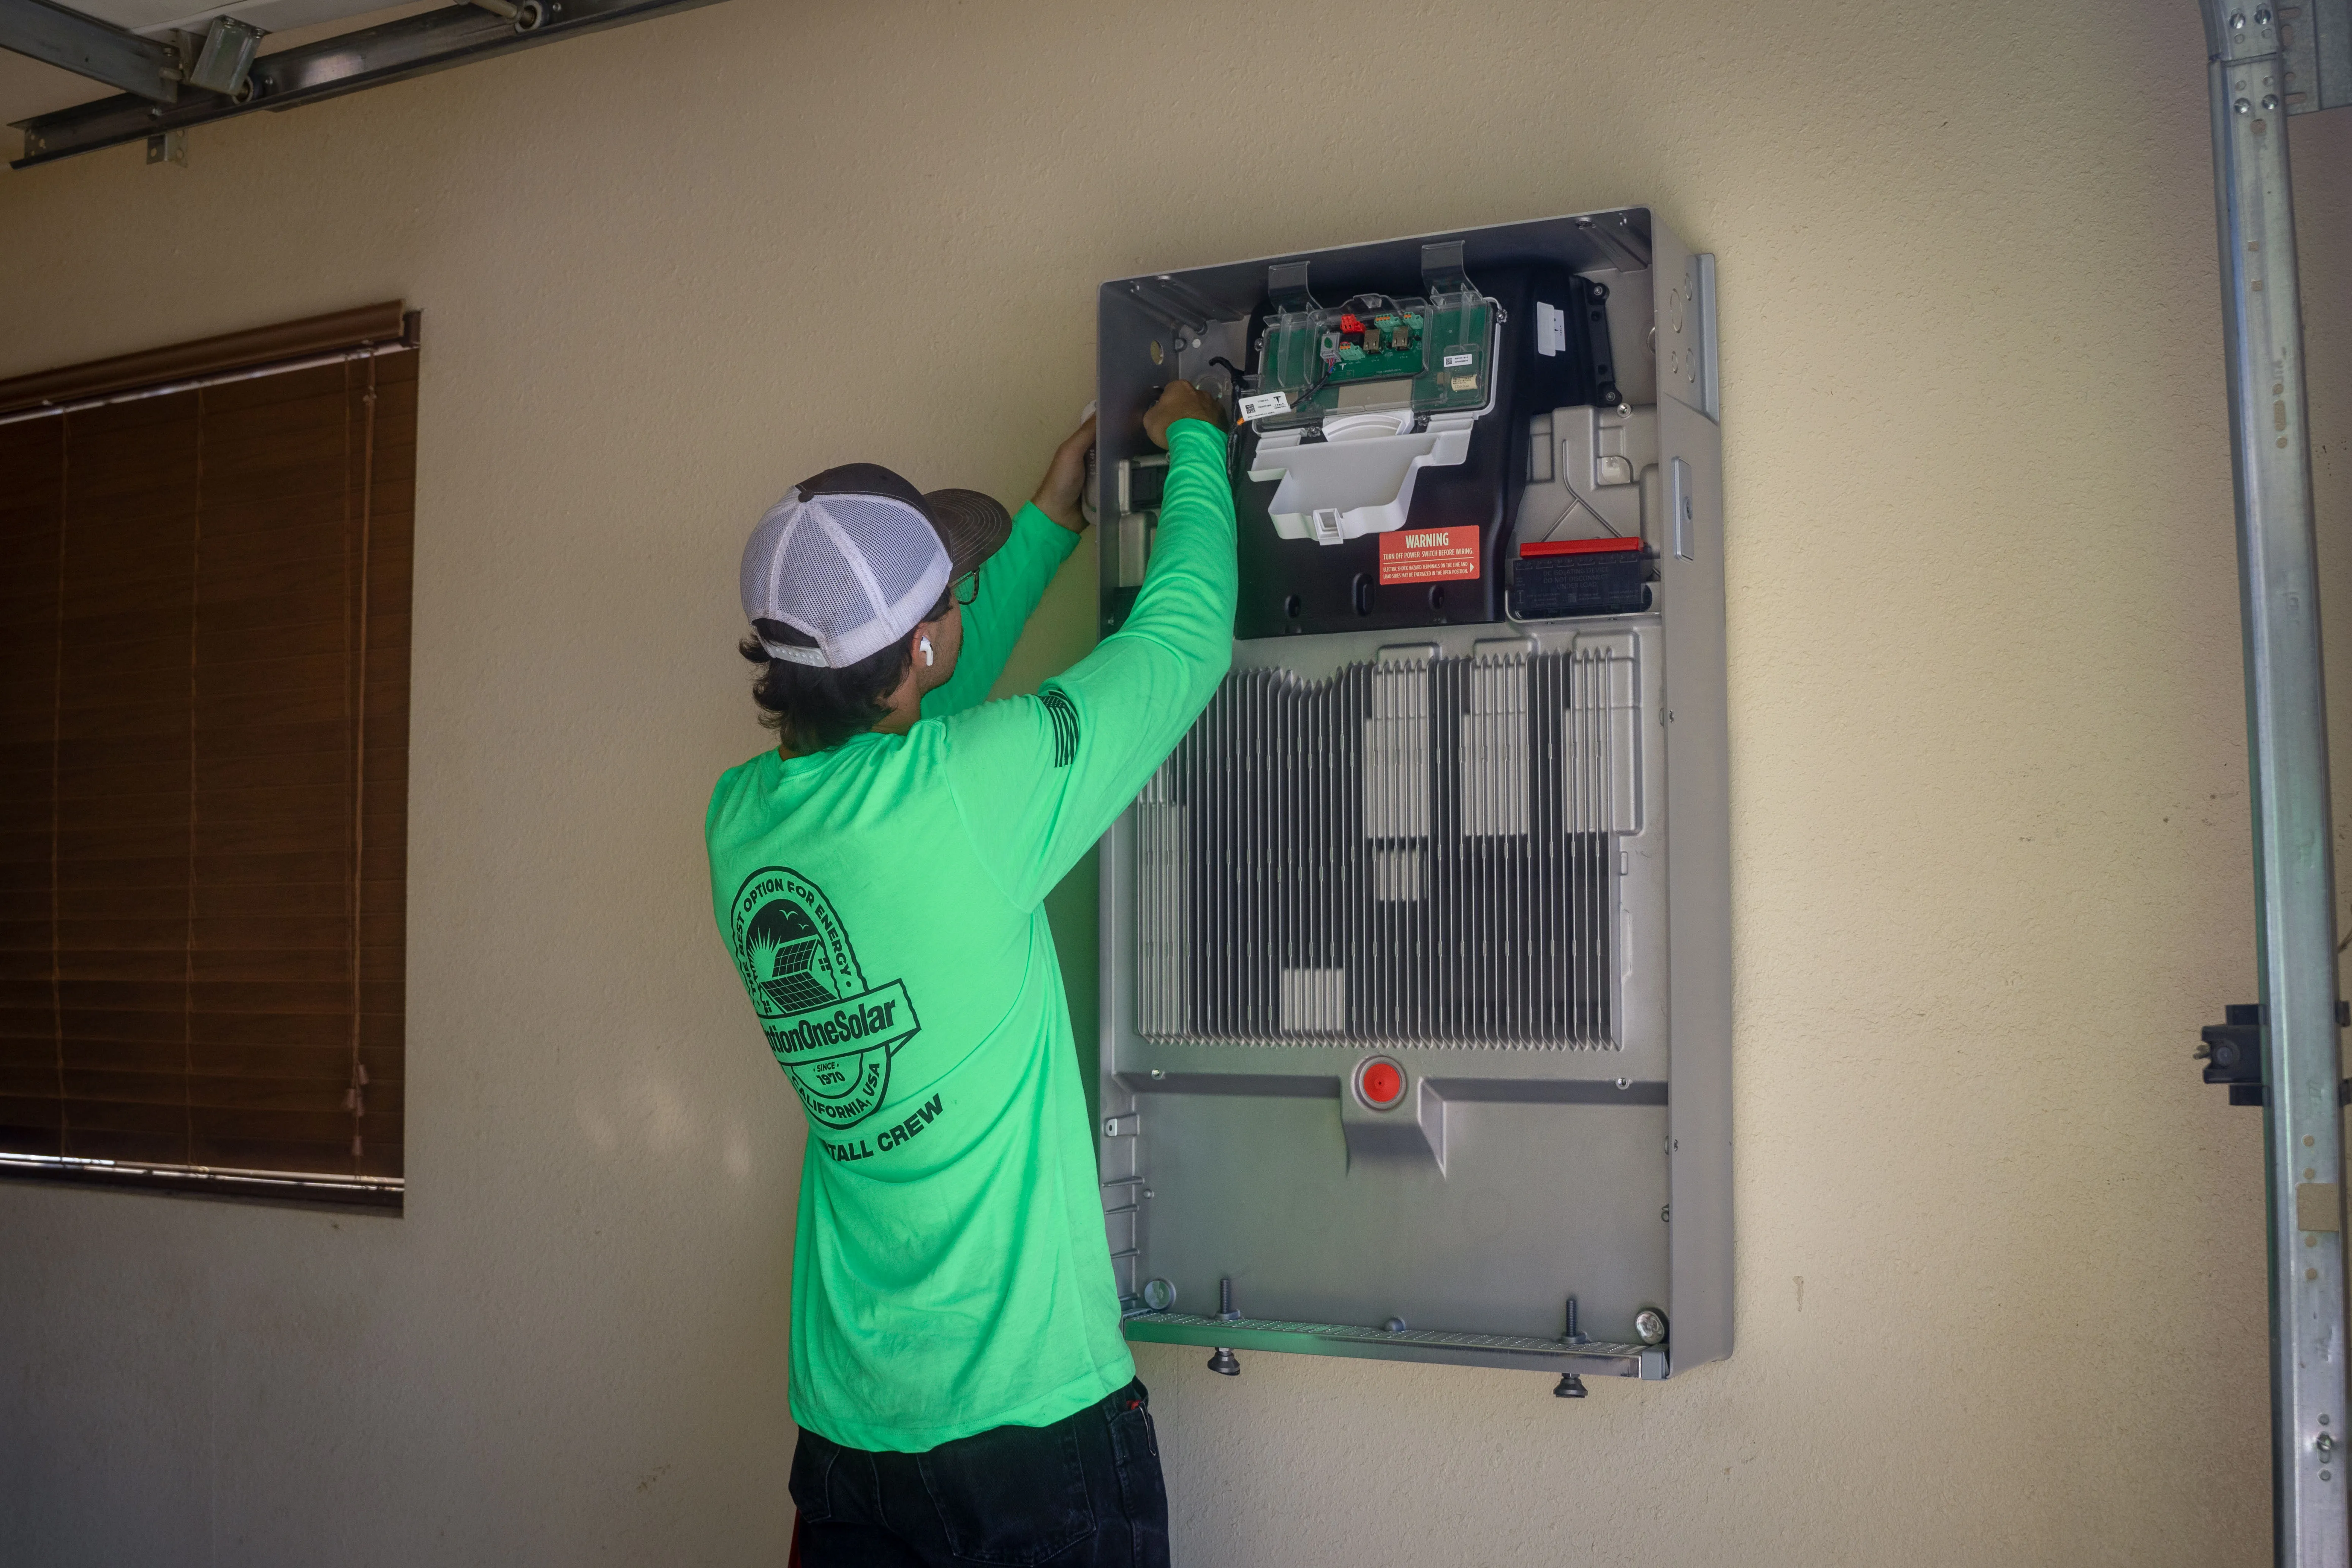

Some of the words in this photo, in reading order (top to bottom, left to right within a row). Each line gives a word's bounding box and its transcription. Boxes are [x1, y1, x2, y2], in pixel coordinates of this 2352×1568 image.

[1405, 532, 1449, 548] WARNING
[1569, 574, 1609, 582] DISCONNECT
[743, 878, 784, 912] OPTION
[787, 880, 814, 908] FOR
[737, 910, 745, 957] BEST
[815, 904, 852, 976] ENERGY
[743, 961, 757, 996] THE
[764, 999, 896, 1053] ptionOneSolar
[816, 1071, 846, 1085] 1970
[817, 1062, 835, 1072] SINCE
[792, 1076, 872, 1118] CALIFORNIA,
[862, 1063, 880, 1097] USA
[823, 1140, 874, 1162] TALL
[877, 1093, 943, 1152] CREW
